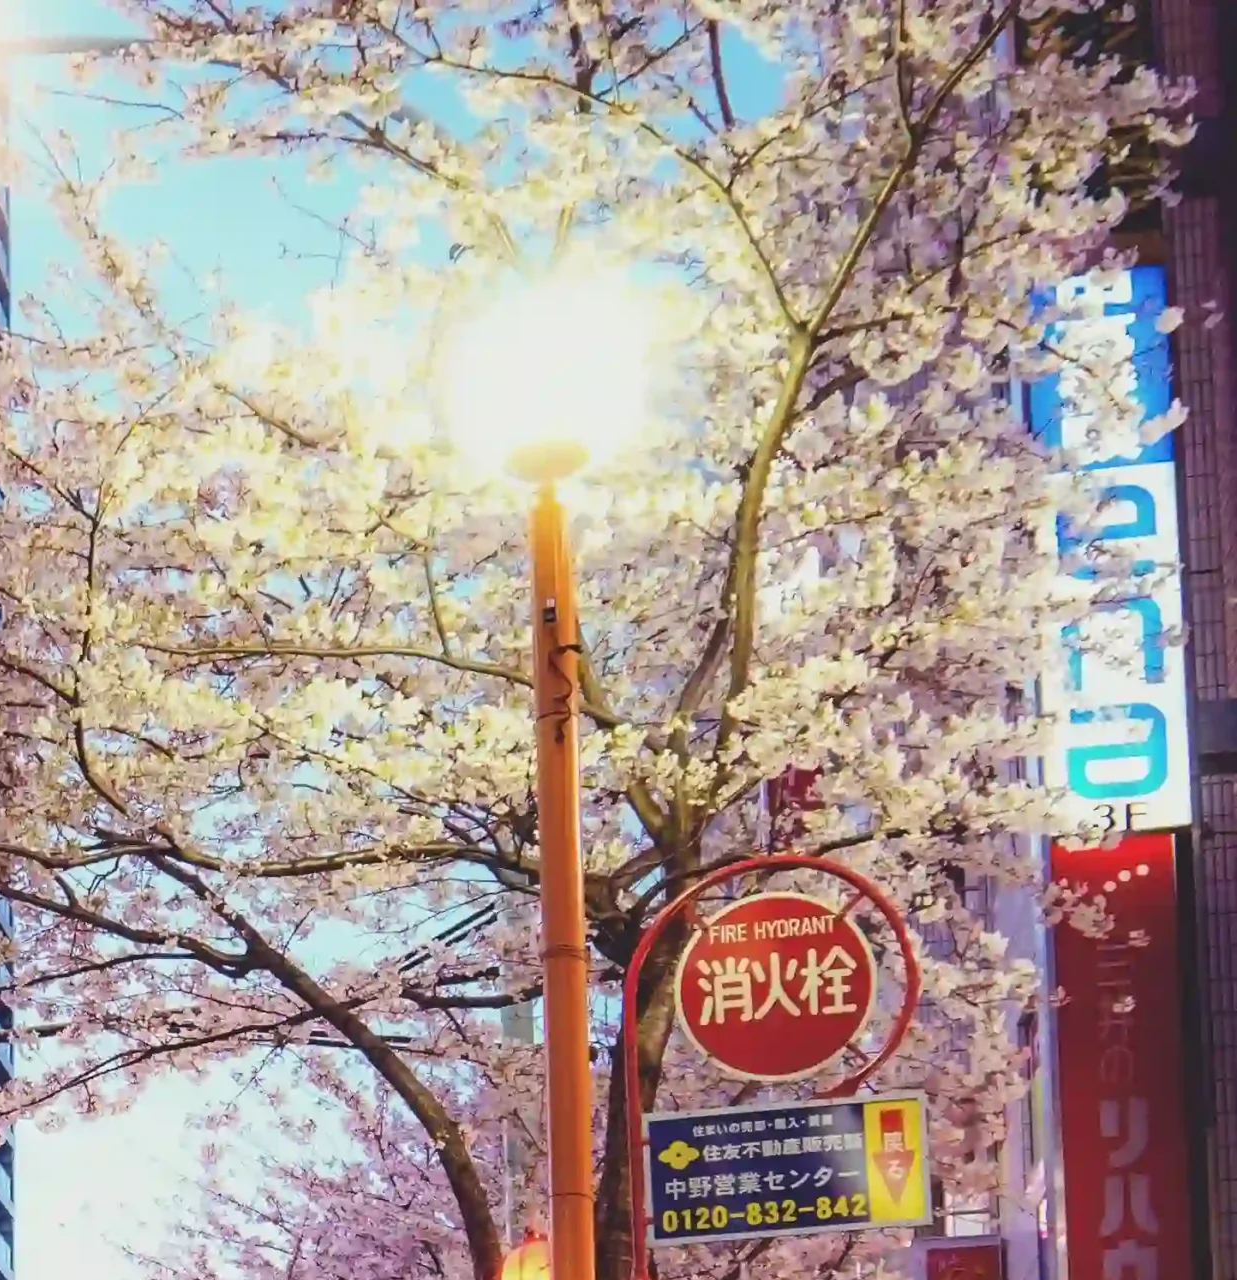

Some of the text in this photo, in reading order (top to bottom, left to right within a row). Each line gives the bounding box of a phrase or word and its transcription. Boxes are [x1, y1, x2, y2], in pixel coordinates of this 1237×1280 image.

[709, 915, 836, 945] FIRE HYDRANT
[697, 945, 858, 1026] 消火栓
[664, 1165, 861, 1202] 中野営業センター
[662, 1193, 868, 1233] 0120-832-842
